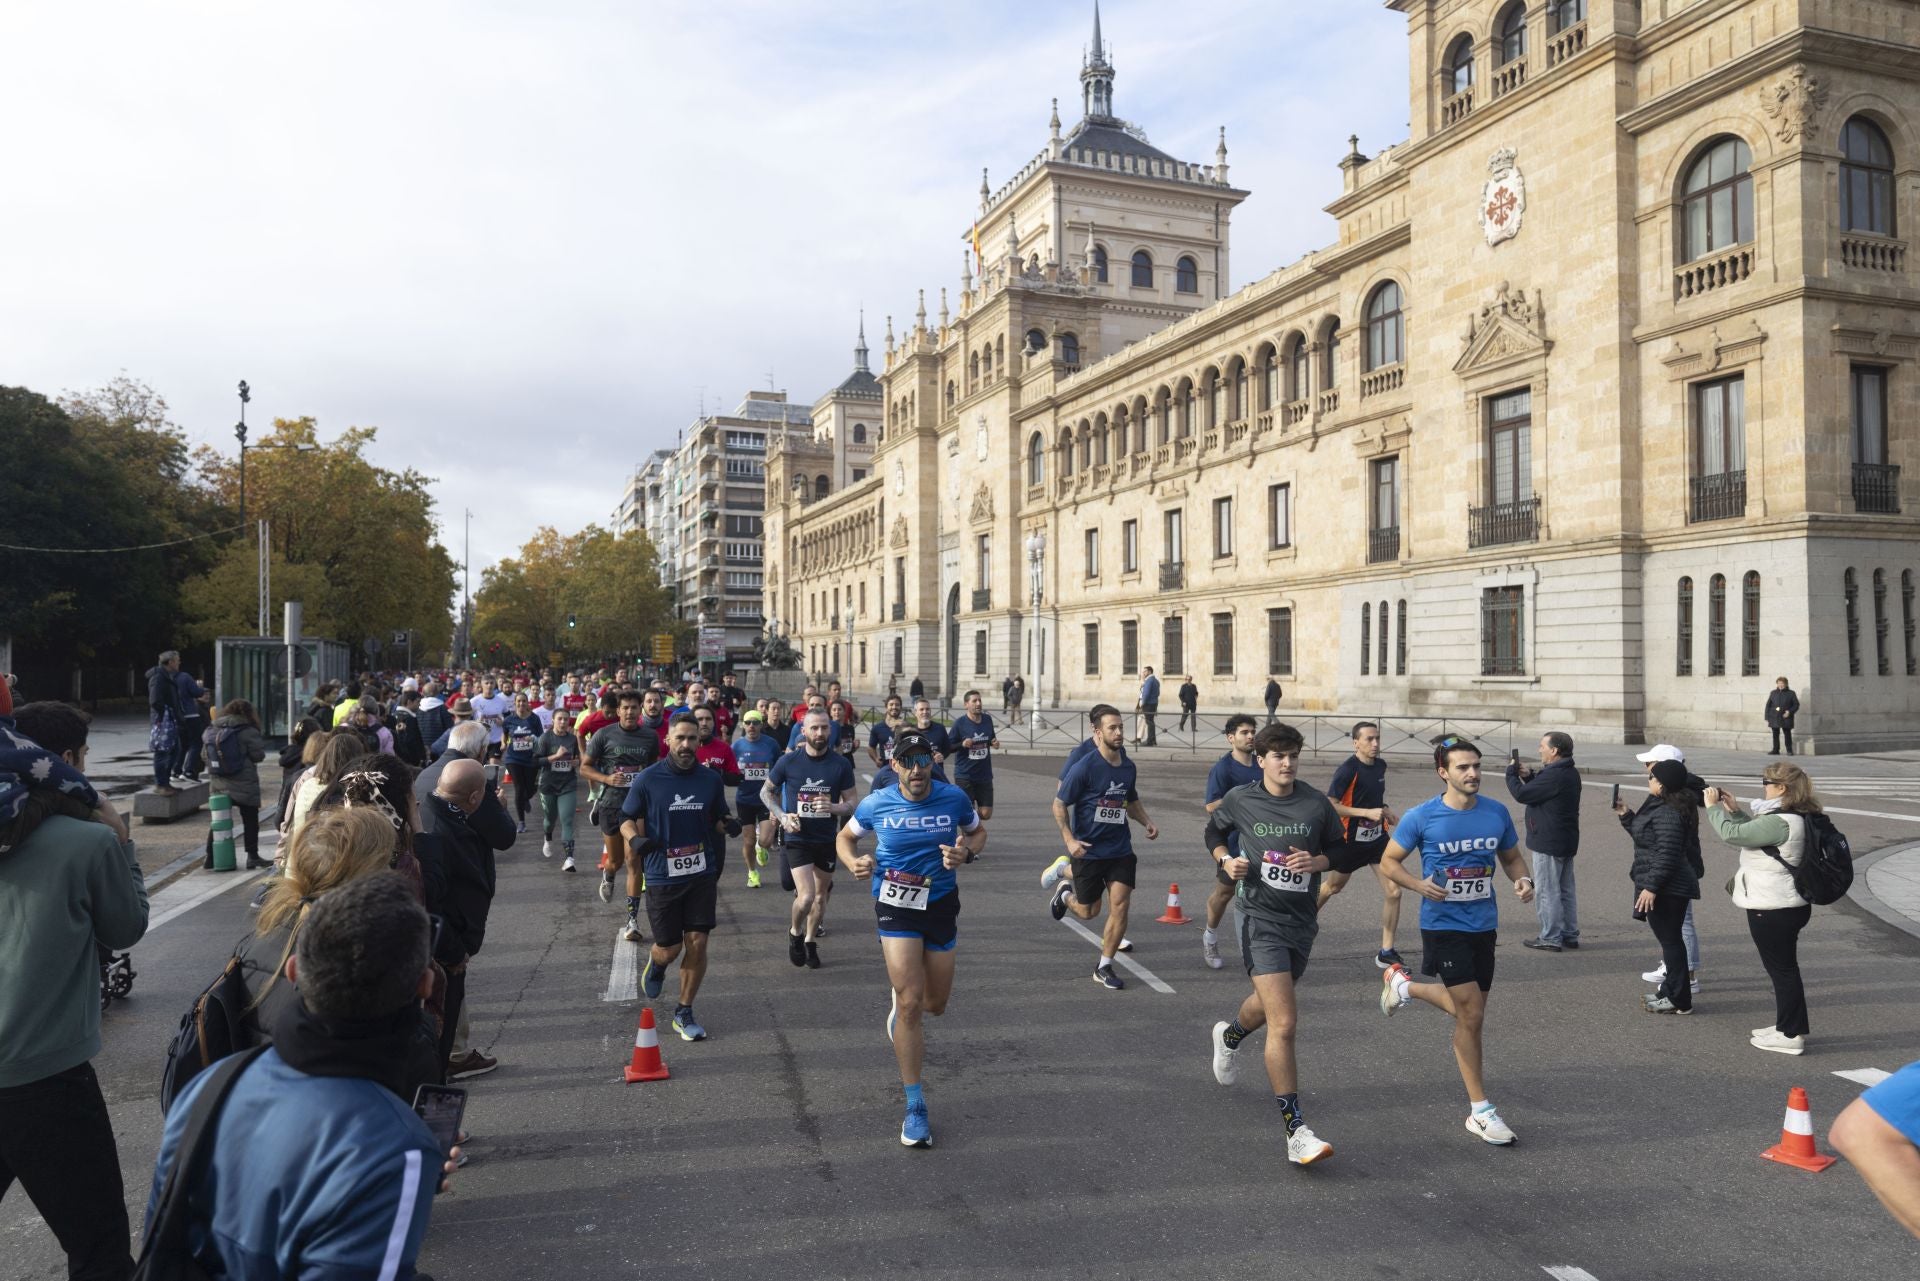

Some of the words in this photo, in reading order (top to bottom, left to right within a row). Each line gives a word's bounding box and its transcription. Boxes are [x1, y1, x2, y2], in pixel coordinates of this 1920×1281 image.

[748, 769, 766, 777] 303
[802, 803, 816, 813] 69
[1100, 808, 1121, 819] 696
[883, 814, 952, 829] IVECO
[1438, 837, 1499, 854] IVECO
[673, 855, 701, 870] 694
[1268, 866, 1303, 885] 896
[886, 883, 922, 902] 577
[1452, 879, 1485, 895] 576
